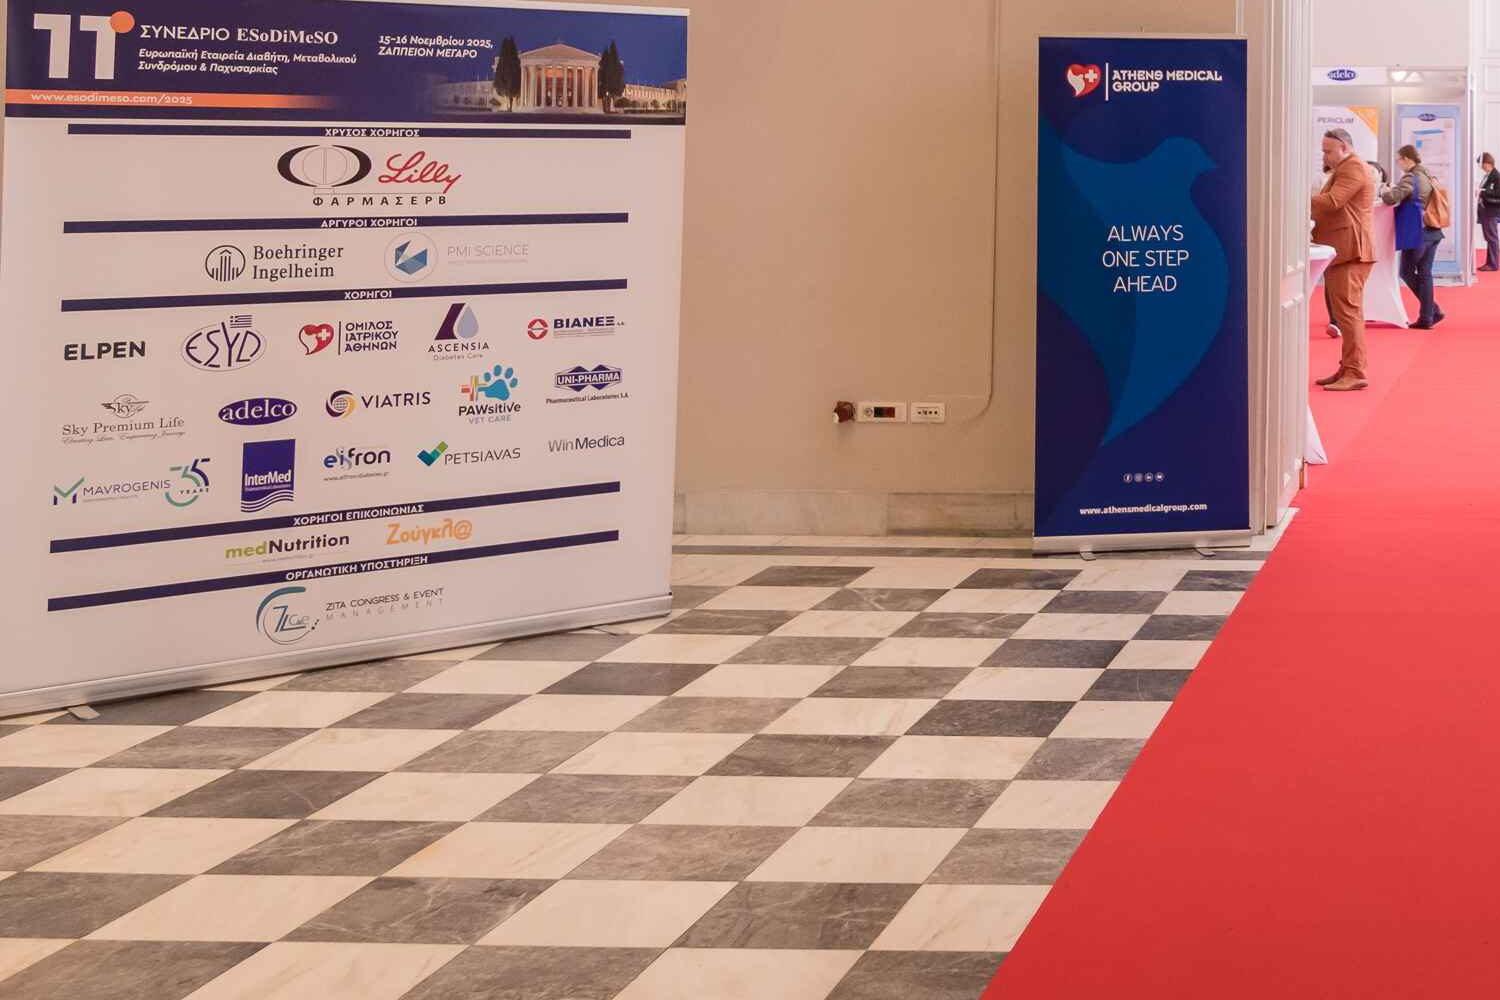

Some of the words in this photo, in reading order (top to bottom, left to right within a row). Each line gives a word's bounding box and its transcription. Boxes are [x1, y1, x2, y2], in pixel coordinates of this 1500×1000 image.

[140, 25, 230, 40] ΣΥΝΕΔΡΙΟ
[237, 28, 339, 45] ESoDiMeSO
[409, 36, 465, 47] Νοεμβρίου
[467, 39, 494, 49] 2025,
[201, 50, 244, 62] Εταιρεία
[378, 46, 434, 57] ΖΑΠΠΕΙΟΝ
[436, 48, 477, 58] ΜΕΓΑΡΟ
[138, 61, 197, 73] Συνδρόμου
[199, 63, 207, 71] &
[209, 62, 278, 75] Παχυσαρκίας
[1112, 70, 1163, 80] ATHENS
[1166, 71, 1223, 81] MEDICAL
[1112, 81, 1160, 92] GROUP
[31, 92, 193, 105] www.esodimeso.com/2025
[325, 126, 367, 137] ΧΡΥΣΟΣ
[370, 128, 420, 137] ΧΟΡΗΓΟΣ
[378, 151, 462, 194] Lilly
[321, 218, 367, 228] ΑΡΓΥΡΟΙ
[370, 218, 417, 227] ΧΟΡΗΓΟΙ
[1107, 225, 1184, 241] ALWAYS
[253, 244, 343, 261] Boehringer
[1102, 250, 1139, 267] ONE
[1145, 250, 1189, 267] STEP
[252, 263, 334, 282] Ingelheim
[1113, 275, 1177, 292] AHEAD
[344, 290, 392, 300] ΧΟΡΗΓΟΙ
[345, 321, 392, 331] ΟΜΙΛΟΣ
[345, 330, 399, 342] ΙΑΤΡΙΚΟΥ
[64, 341, 146, 361] ELPEN
[344, 341, 397, 353] ΑΘΗΝΩΝ
[428, 341, 489, 353] ASCENSIA
[557, 372, 620, 385] UNI-PHARMA
[361, 391, 431, 409] VIATRIS
[221, 401, 295, 421] adelco
[458, 401, 521, 417] PAWsitive
[62, 424, 88, 436] Sky
[93, 421, 154, 433] Premium
[160, 417, 185, 428] Life
[444, 448, 521, 465] PETSIAVAS
[245, 470, 291, 486] InterMed
[83, 479, 171, 497] MAVROGENIS
[294, 514, 343, 526] ΧΟΡΗΓΟΙ
[346, 504, 424, 521] ΕΠΙΚΟΙΝΩΝΙΑΣ
[1080, 503, 1208, 515] www.athensmedicalgroup.com
[225, 535, 350, 559] medNutrition
[286, 562, 358, 581] ΟΡΓΑΝΩΤΙΚΗ
[360, 555, 428, 572] ΥΠΟΣΤΗΡΙΞΗ
[326, 602, 346, 611] ZITA
[350, 594, 400, 607] CONGRESS
[413, 588, 444, 599] EVENT
